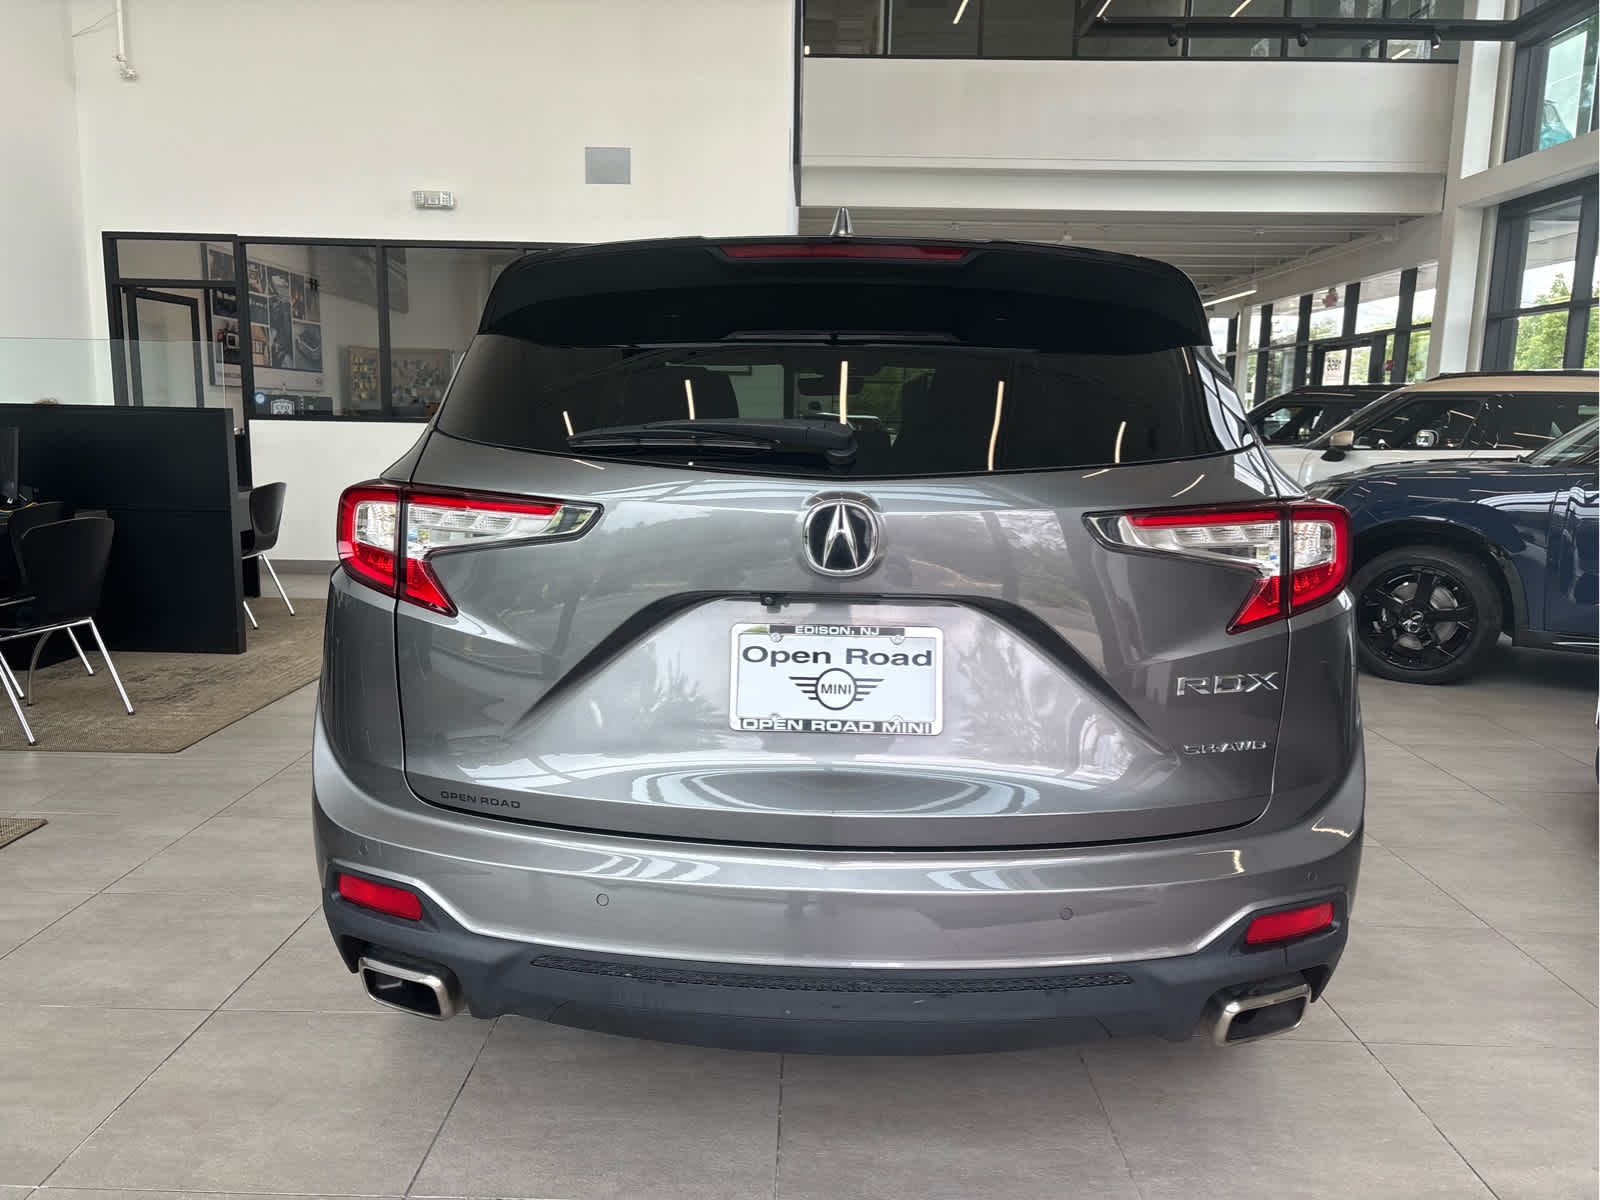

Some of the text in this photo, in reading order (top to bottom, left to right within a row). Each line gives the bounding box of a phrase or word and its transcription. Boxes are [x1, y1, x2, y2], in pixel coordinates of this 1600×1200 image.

[794, 625, 881, 636] EDISON, NJ
[742, 645, 933, 667] Open Road
[820, 683, 852, 695] MINI
[1176, 671, 1279, 696] RDX
[742, 718, 932, 734] OPEN ROAD MINI
[440, 790, 521, 809] OPEN ROAD
